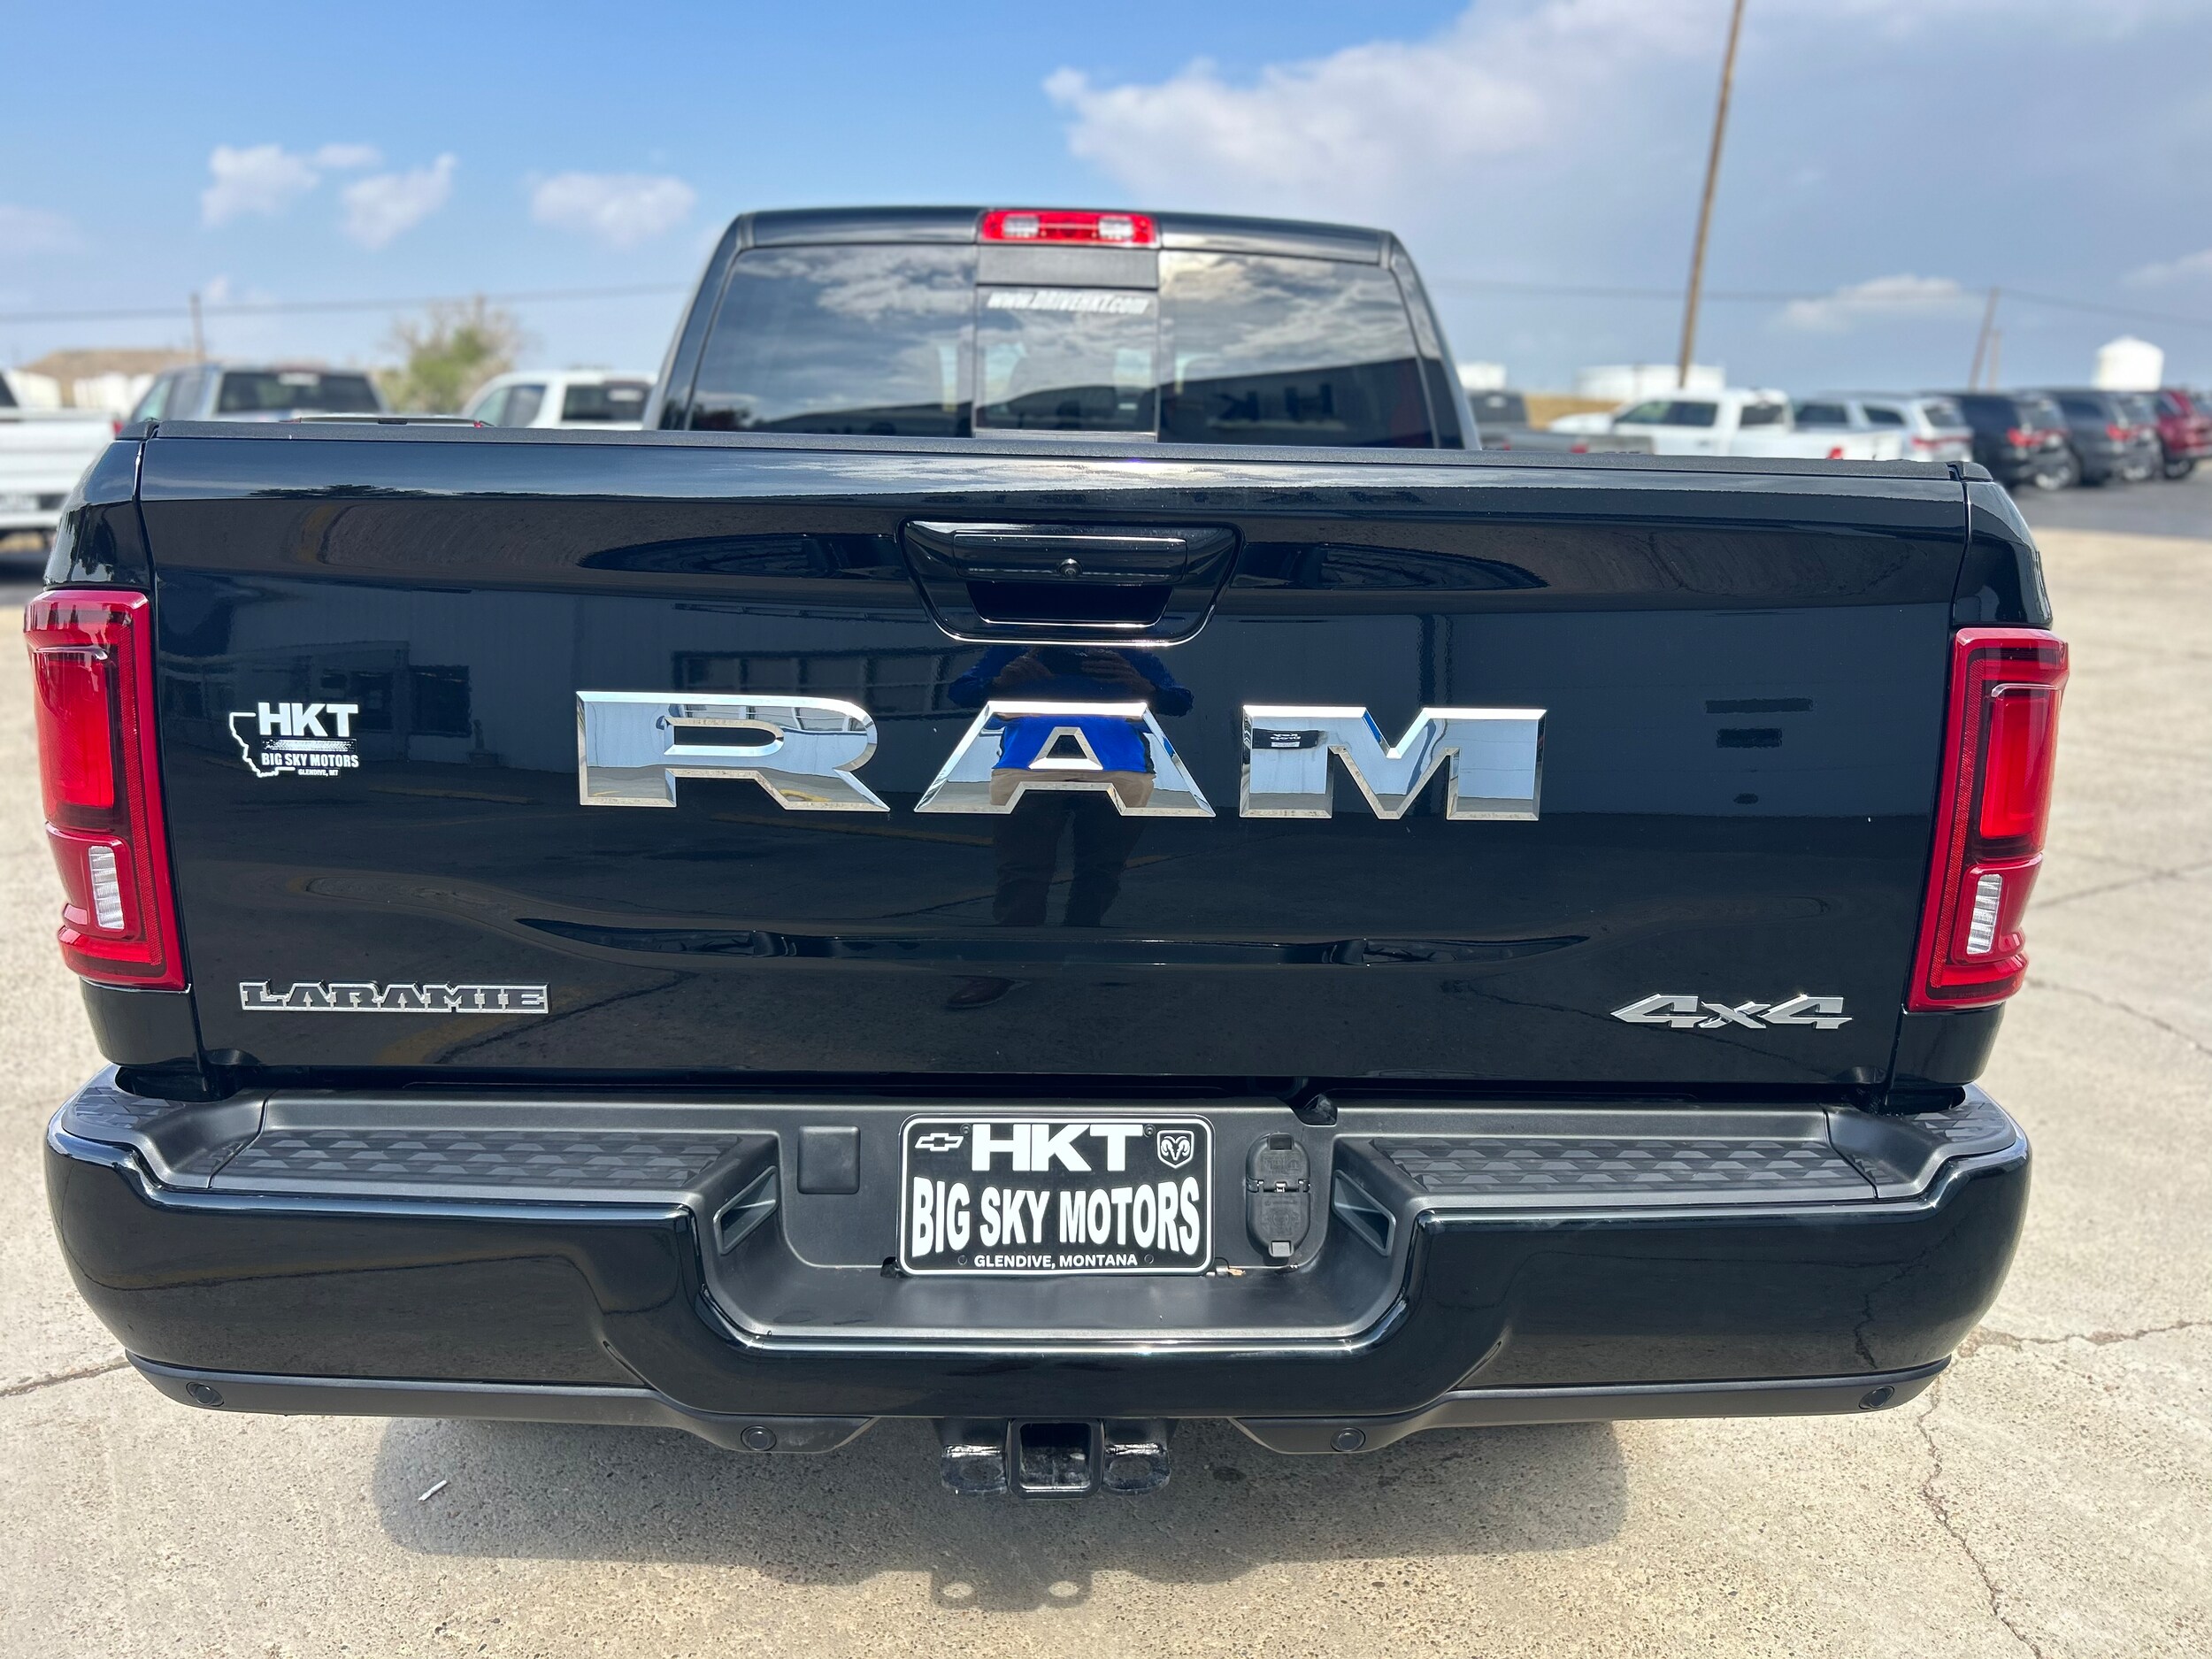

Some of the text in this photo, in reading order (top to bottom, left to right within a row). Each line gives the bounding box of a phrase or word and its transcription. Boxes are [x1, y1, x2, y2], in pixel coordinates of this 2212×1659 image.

[257, 702, 359, 737] HKT
[261, 752, 359, 768] BIG SKY MOTORS
[575, 690, 1548, 821] RAM
[239, 979, 550, 1015] LARAMIE
[1609, 993, 1853, 1030] 4x4
[972, 1123, 1144, 1171] HKT
[911, 1176, 1201, 1257] BIG SKY MOTORS
[974, 1253, 1138, 1270] GLENDIVE, MONTANA
